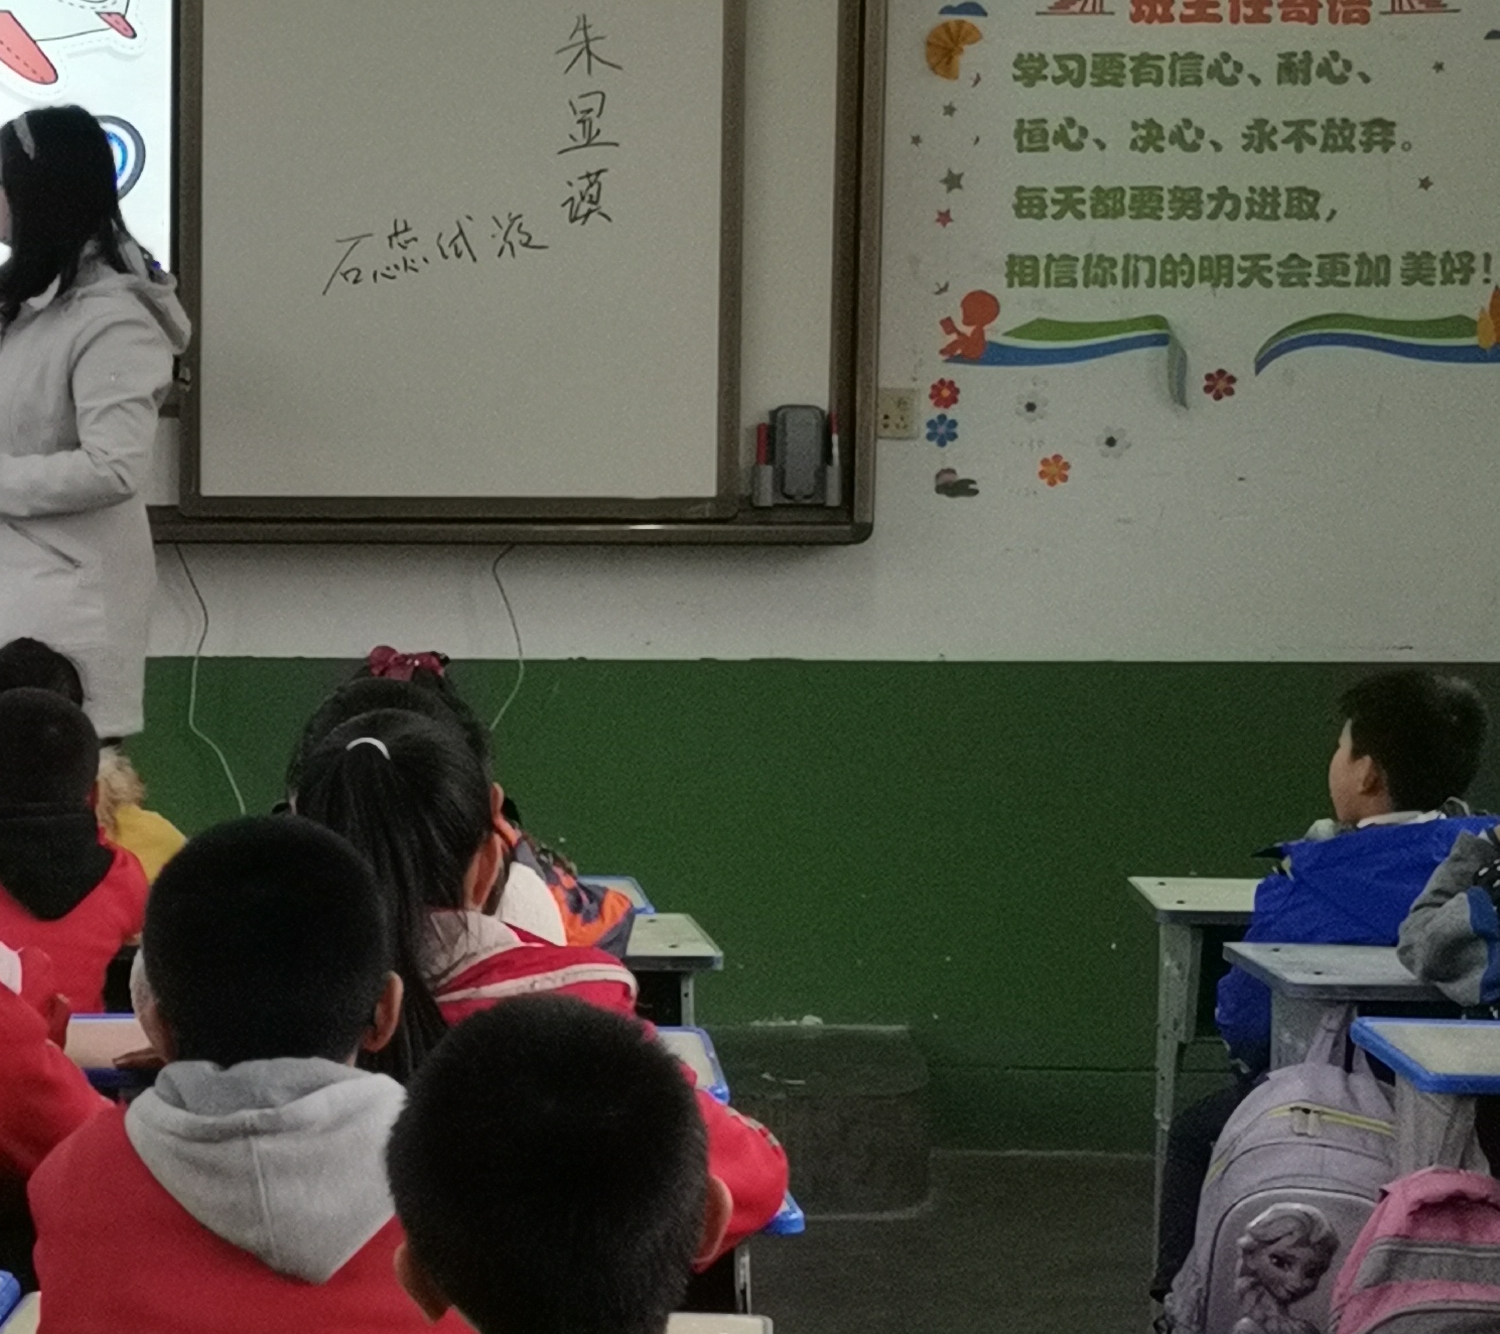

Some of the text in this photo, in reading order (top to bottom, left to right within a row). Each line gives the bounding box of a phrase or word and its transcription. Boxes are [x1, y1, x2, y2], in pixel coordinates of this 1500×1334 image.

[1012, 49, 1372, 88] 学习要有信心、耐心、
[1013, 116, 1414, 155] 恒心、决心、永不放弃。
[1012, 185, 1337, 223] 每天都要努力进取，
